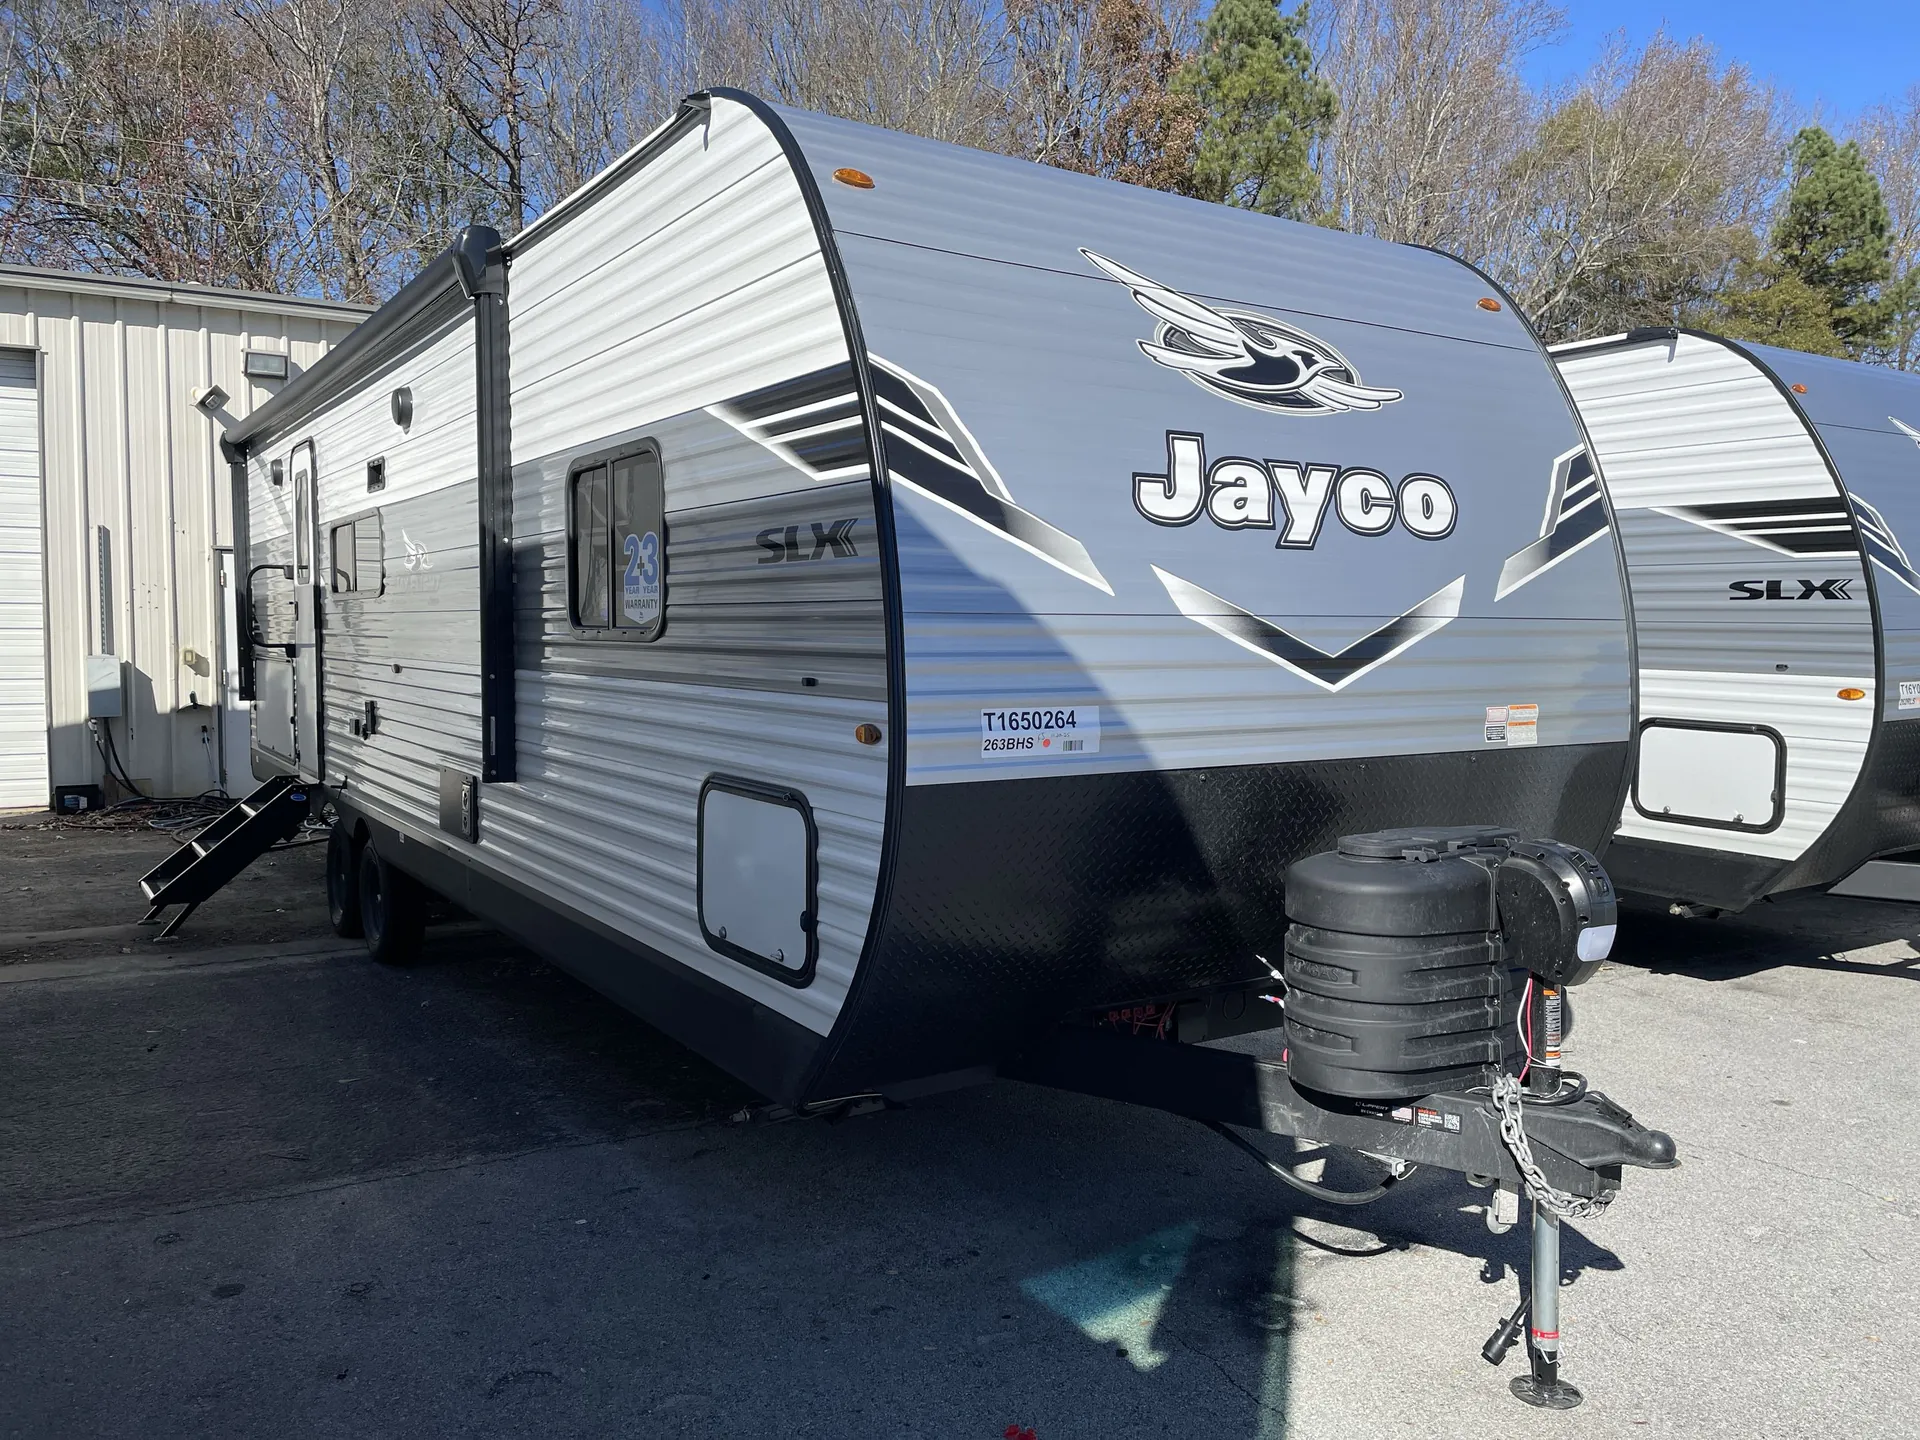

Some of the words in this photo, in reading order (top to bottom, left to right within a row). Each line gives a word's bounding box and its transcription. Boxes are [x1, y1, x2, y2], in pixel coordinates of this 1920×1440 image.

[1132, 430, 1458, 550] Jayco
[756, 518, 859, 564] SLX
[625, 587, 640, 595] YEAR
[643, 586, 658, 594] YEAR
[1729, 579, 1853, 600] SLX
[625, 599, 658, 609] WARRANTY
[983, 710, 1077, 731] T1650264
[983, 737, 1034, 751] 263BHS
